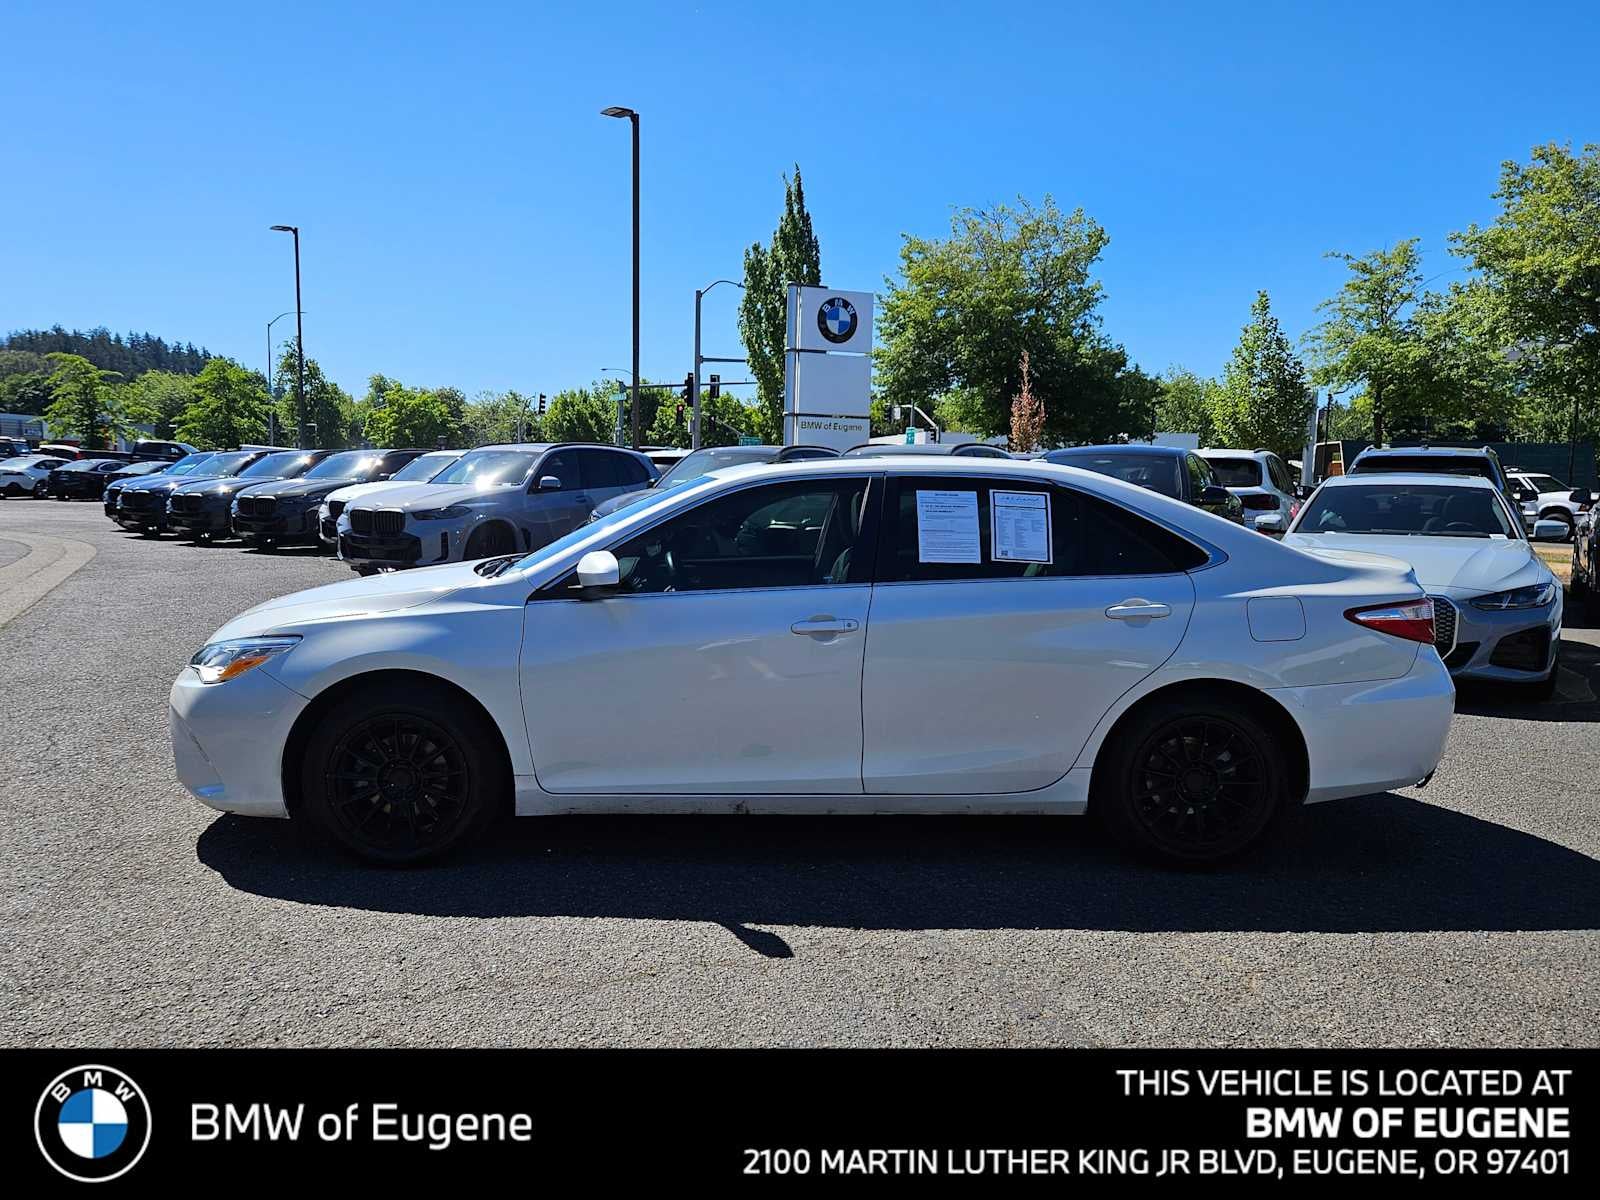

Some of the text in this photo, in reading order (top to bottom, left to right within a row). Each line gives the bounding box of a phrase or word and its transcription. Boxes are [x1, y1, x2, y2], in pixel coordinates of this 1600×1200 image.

[822, 299, 856, 315] BMW
[801, 421, 822, 430] BMW
[823, 422, 832, 430] of
